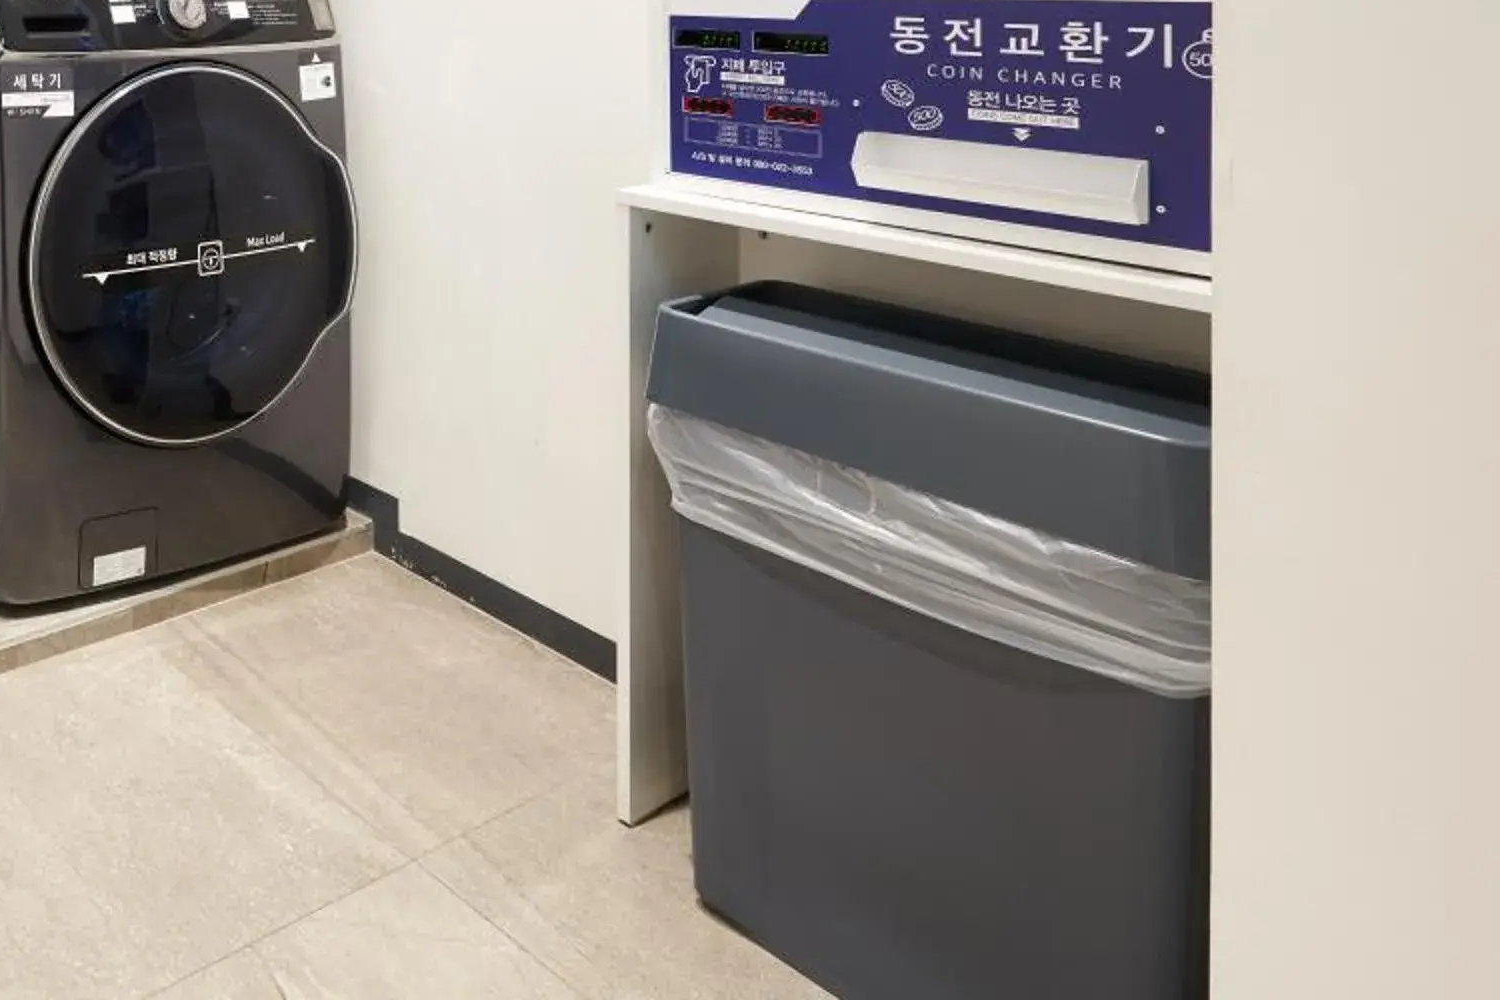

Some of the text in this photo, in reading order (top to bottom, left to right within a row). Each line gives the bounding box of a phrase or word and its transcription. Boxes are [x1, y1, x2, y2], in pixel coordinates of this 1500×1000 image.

[927, 63, 1122, 89] COIN CHANGER
[1005, 92, 1057, 112] 나오는
[1061, 96, 1081, 115] 곳
